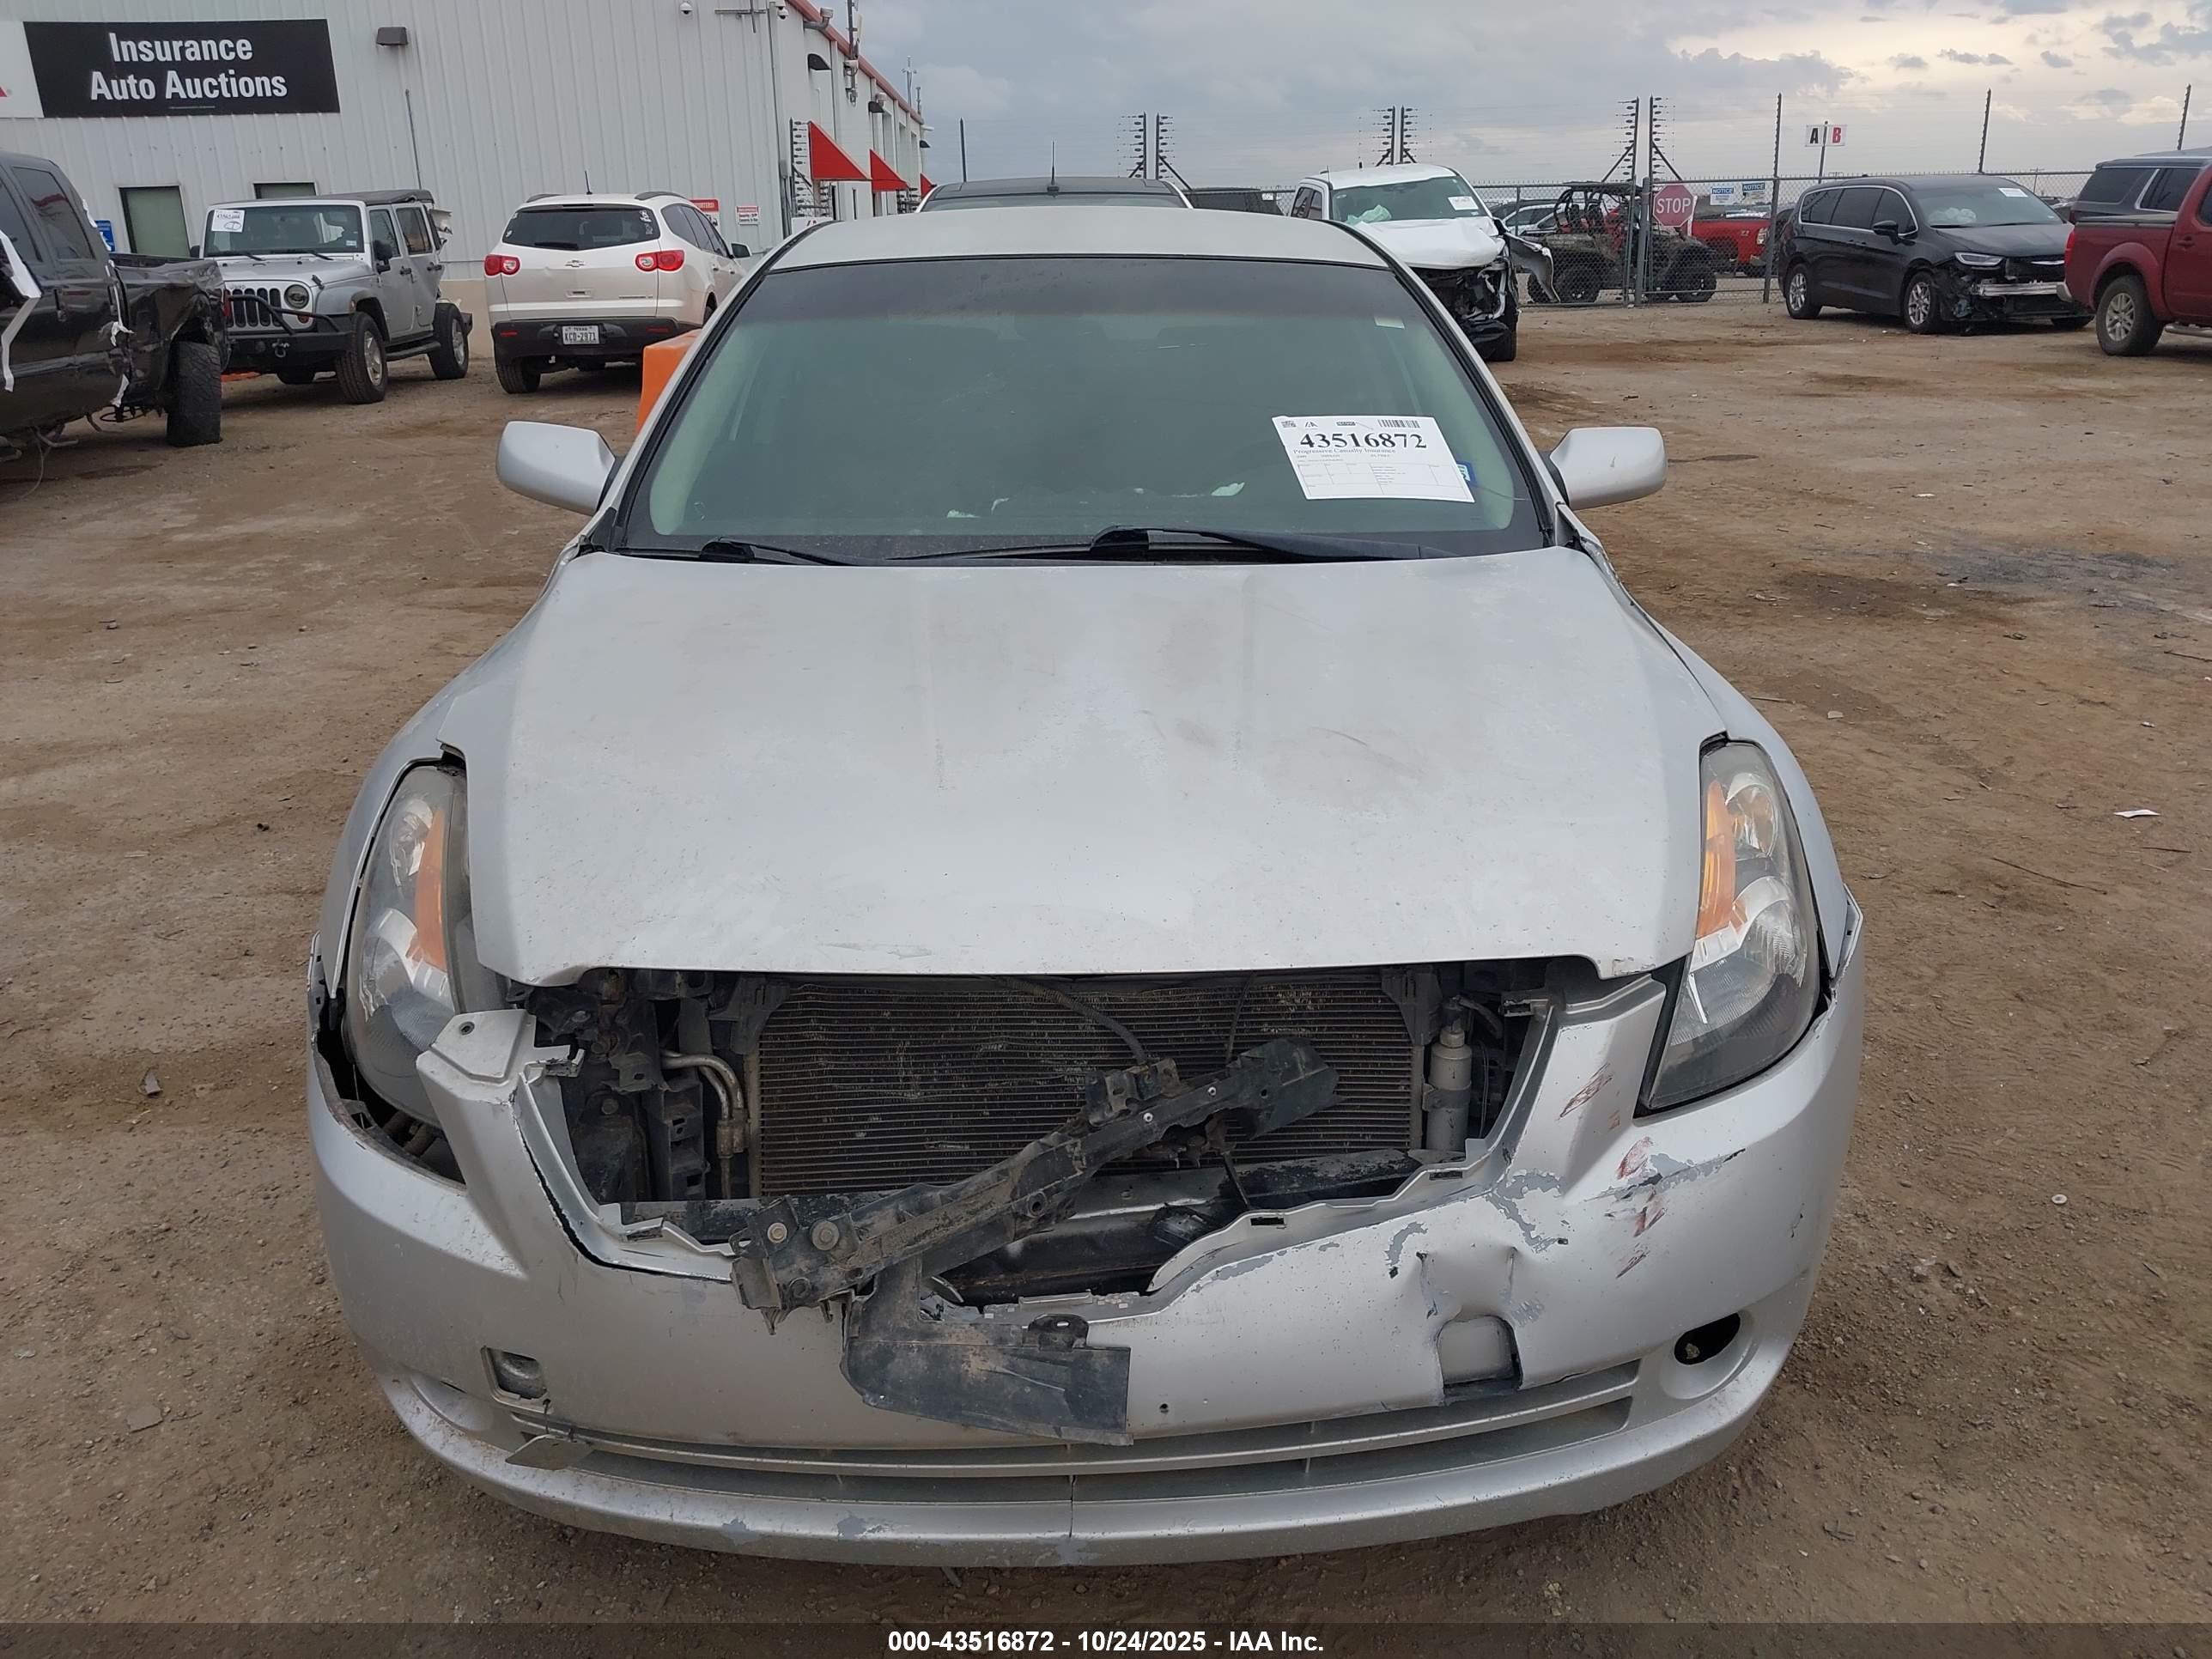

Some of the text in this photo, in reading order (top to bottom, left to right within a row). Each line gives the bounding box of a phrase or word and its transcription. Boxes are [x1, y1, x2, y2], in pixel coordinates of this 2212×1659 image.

[109, 33, 252, 62] Insurance
[91, 70, 288, 100] Auto Auctions
[1809, 127, 1841, 143] A B
[1656, 198, 1691, 214] STOP
[1300, 433, 1427, 449] 43516872
